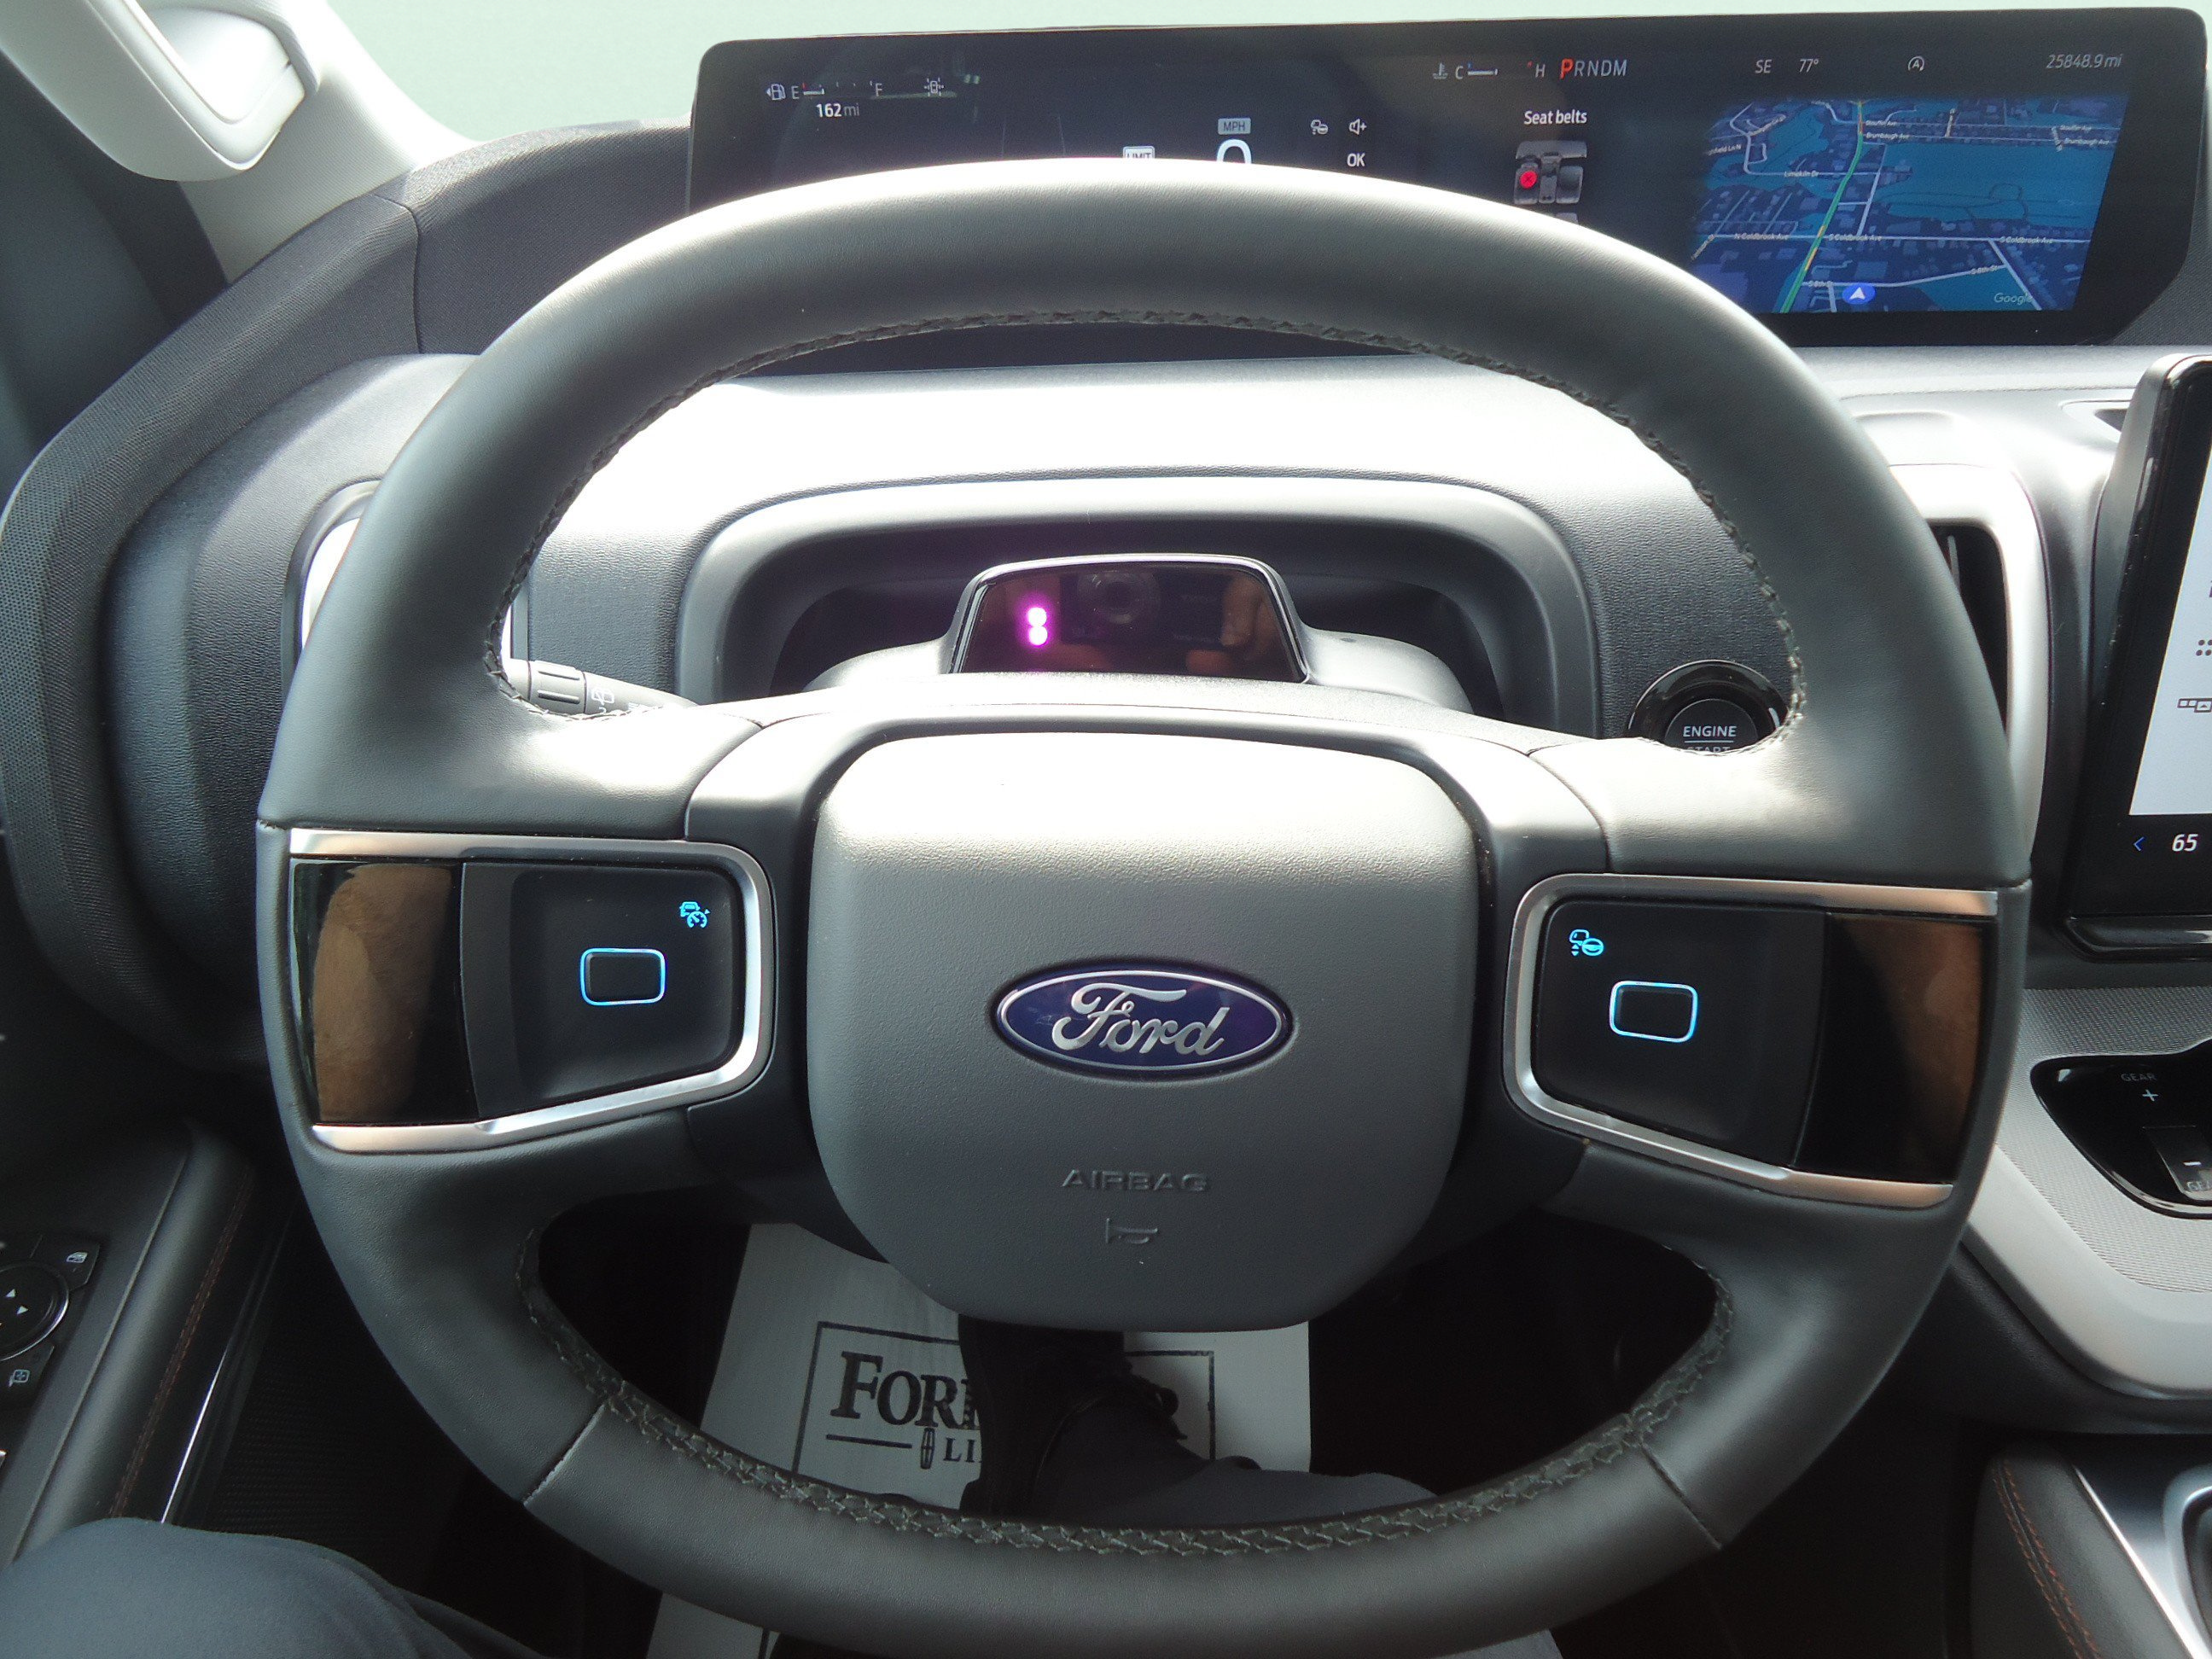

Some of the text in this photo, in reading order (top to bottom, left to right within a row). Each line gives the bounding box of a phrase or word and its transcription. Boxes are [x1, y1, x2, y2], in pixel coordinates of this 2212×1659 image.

[1755, 59, 1773, 74] SE
[2046, 55, 2103, 69] 25848.9
[1454, 65, 1464, 79] C
[1535, 63, 1545, 78] H
[791, 85, 800, 100] E
[875, 83, 883, 97] F
[815, 102, 842, 118] 162
[1523, 109, 1587, 125] Seat belts
[1223, 121, 1246, 131] MPH
[1347, 153, 1365, 167] OK
[1994, 292, 2034, 306] Google
[1683, 725, 1738, 737] ENGINE
[2172, 833, 2198, 853] 65
[1051, 982, 1231, 1057] Ford
[2121, 1073, 2157, 1082] GEAR
[1061, 1168, 1210, 1193] AIRBAG
